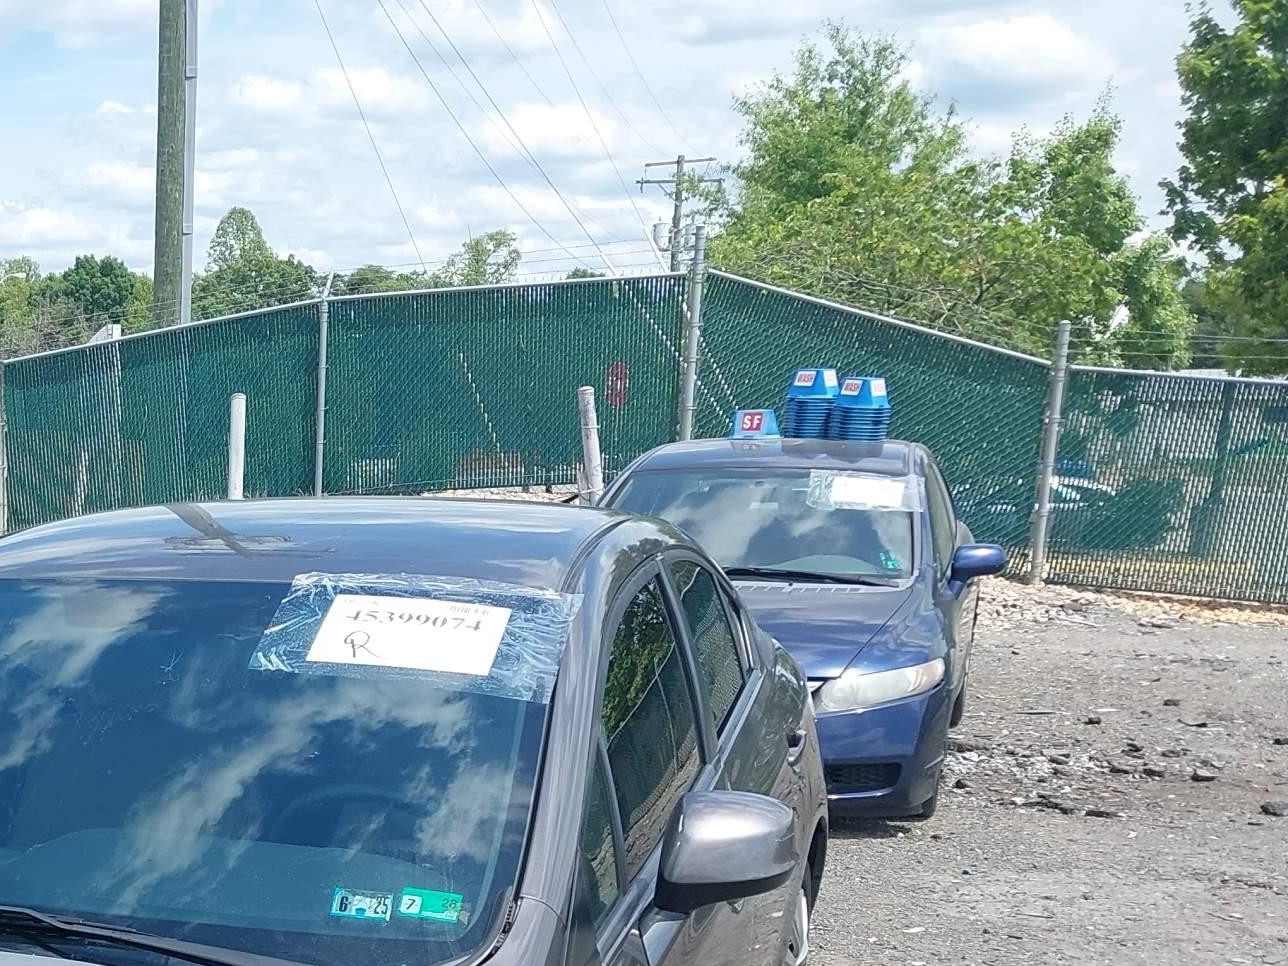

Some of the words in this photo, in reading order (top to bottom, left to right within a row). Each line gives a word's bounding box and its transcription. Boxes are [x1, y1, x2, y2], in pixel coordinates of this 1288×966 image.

[346, 610, 481, 631] 45399074
[374, 896, 388, 914] 25
[406, 898, 416, 910] 7
